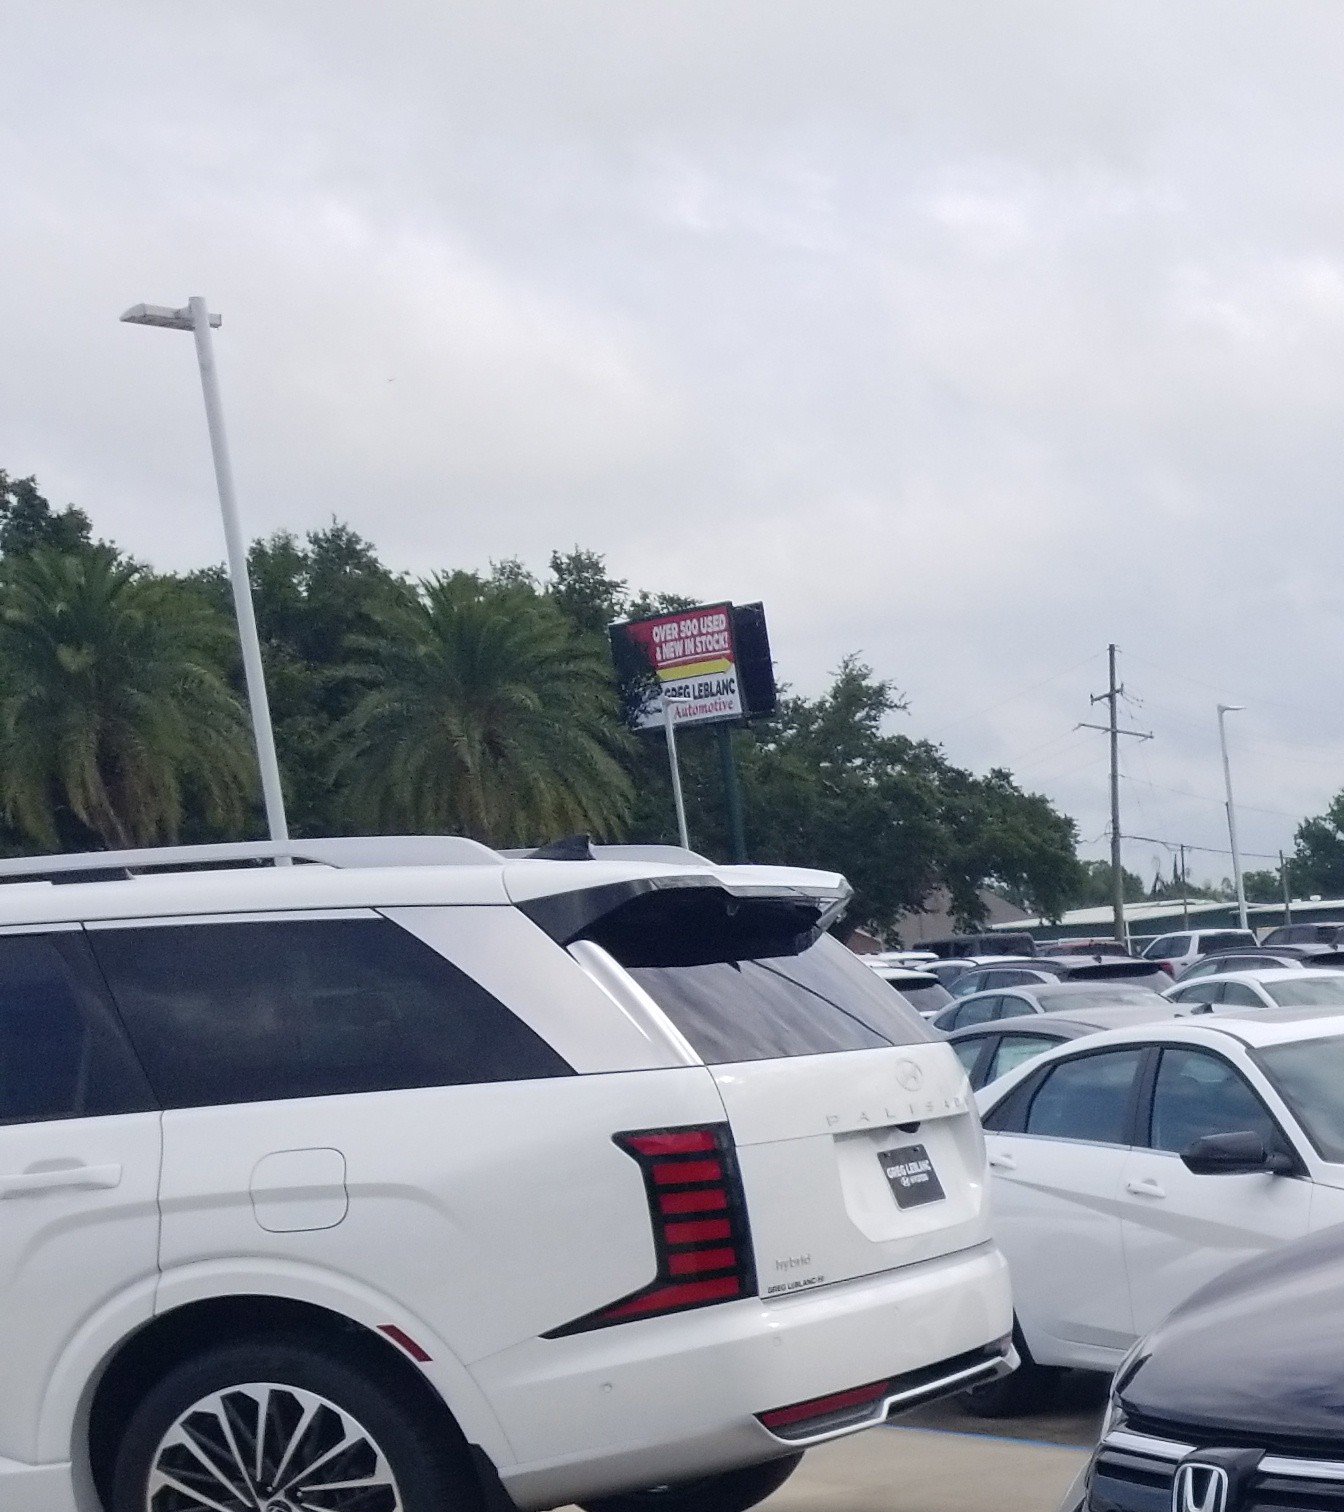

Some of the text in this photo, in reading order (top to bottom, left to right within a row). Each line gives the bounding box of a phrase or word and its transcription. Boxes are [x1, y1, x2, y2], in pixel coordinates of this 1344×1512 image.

[652, 613, 727, 644] OVER 500 USED
[662, 640, 684, 660] NEW
[685, 637, 695, 655] IN
[695, 631, 729, 653] STOCK!
[692, 677, 736, 700] LEBLANC
[674, 698, 734, 718] Automotive
[775, 1253, 811, 1271] hybrid
